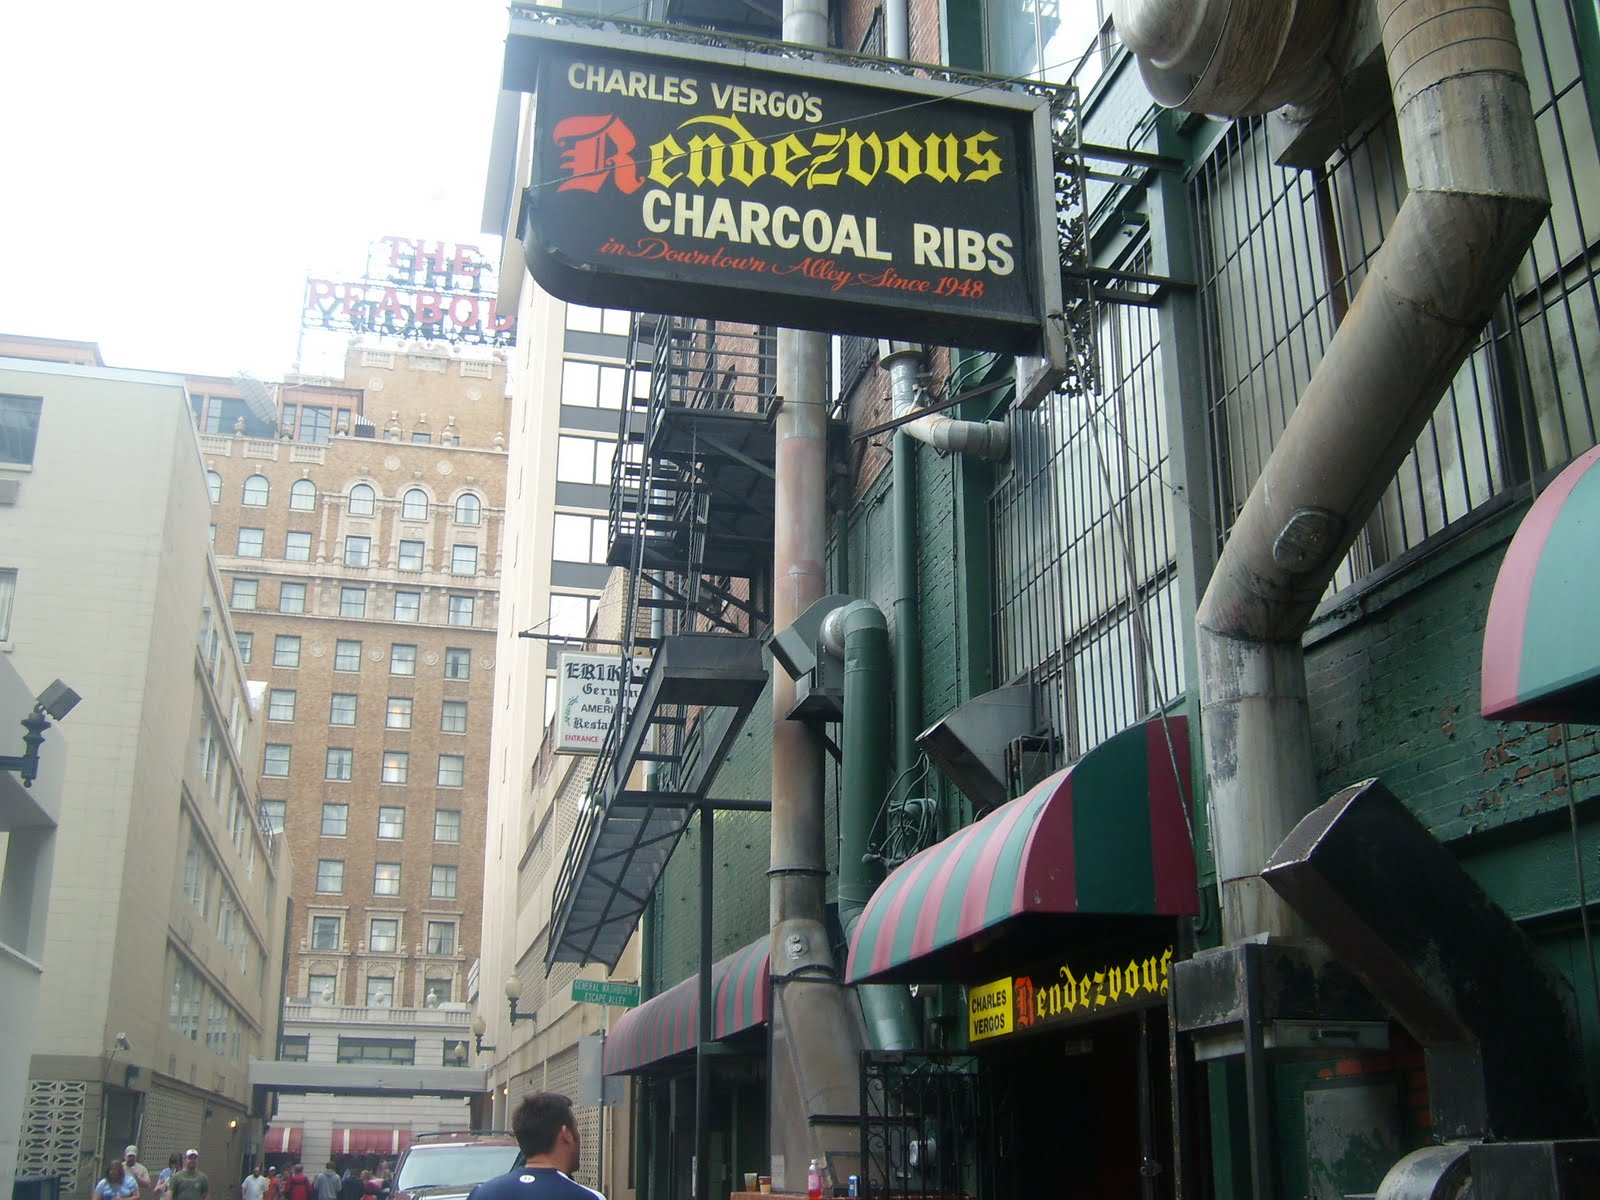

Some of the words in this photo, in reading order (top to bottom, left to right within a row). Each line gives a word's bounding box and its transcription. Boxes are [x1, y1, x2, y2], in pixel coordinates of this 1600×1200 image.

[568, 62, 698, 106] CHARLES
[711, 82, 823, 123] VERGO'S
[552, 113, 1003, 195] Rendezvous
[380, 235, 482, 277] THE
[642, 189, 892, 262] CHARCOAL
[913, 223, 1015, 276] RIBS
[600, 235, 626, 256] in
[627, 237, 770, 273] Downtown
[772, 257, 851, 292] Alley
[851, 267, 931, 292] Since
[934, 277, 984, 299] 1948
[565, 734, 598, 743] ENTRANCE
[584, 992, 606, 1004] ESCAPE
[608, 995, 627, 1006] ALLEY
[972, 989, 1007, 1014] CHARLES
[1014, 945, 1173, 1030] Rendezvous
[974, 1013, 1005, 1036] VERGOS
